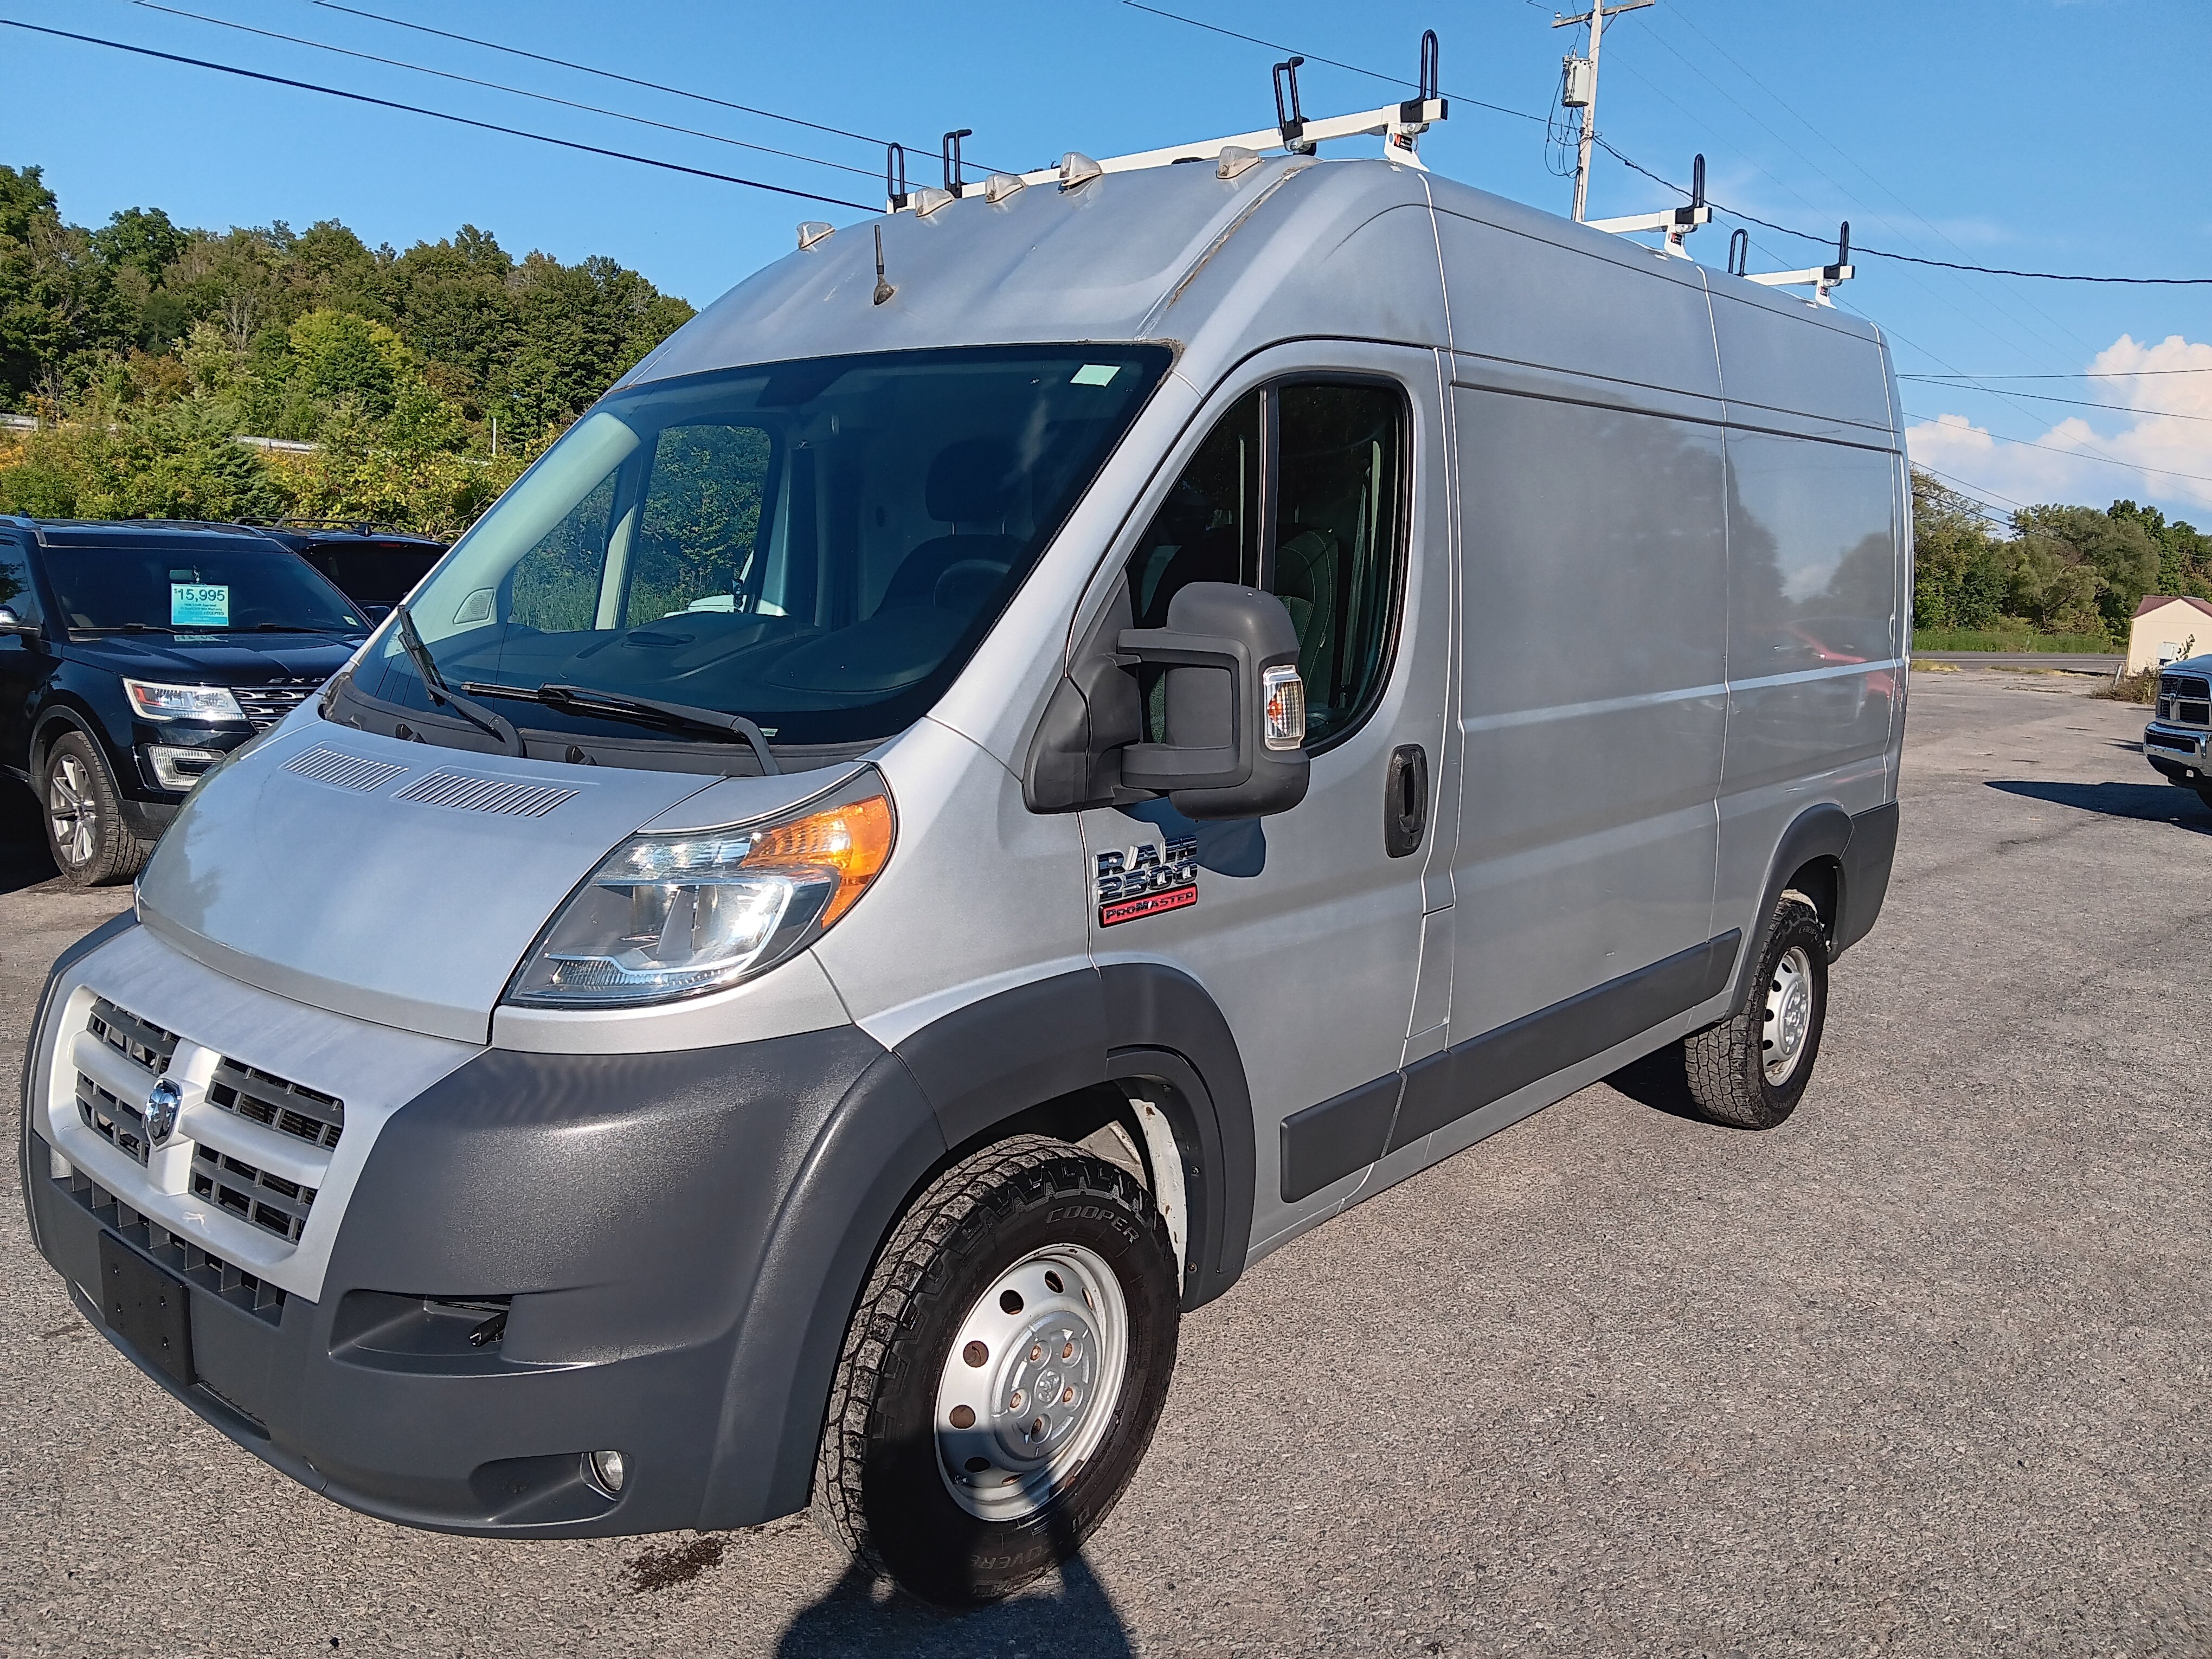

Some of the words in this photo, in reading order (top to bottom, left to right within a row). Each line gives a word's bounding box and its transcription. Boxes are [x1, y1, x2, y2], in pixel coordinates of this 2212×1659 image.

[174, 588, 225, 602] $15,995
[1091, 835, 1197, 879] RAM
[1097, 858, 1198, 902] 2500
[1046, 1205, 1140, 1244] COOPER
